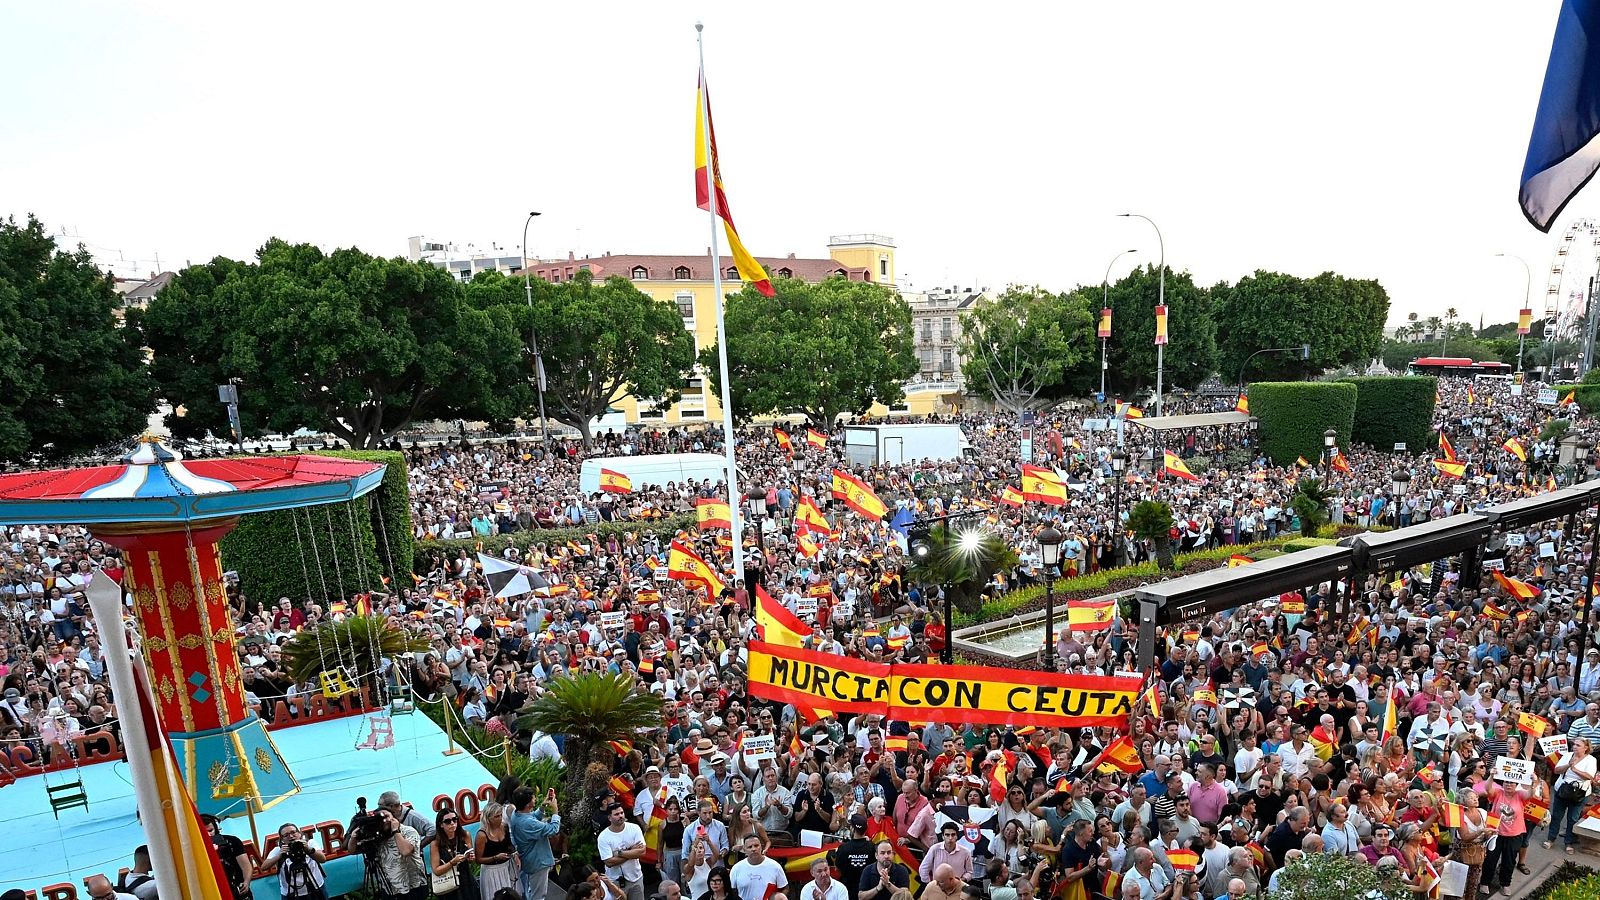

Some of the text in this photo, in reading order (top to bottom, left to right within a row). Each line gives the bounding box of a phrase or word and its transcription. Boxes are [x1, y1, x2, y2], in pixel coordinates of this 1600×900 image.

[769, 656, 1132, 717] MURCIA CON CEUTA
[1505, 760, 1525, 768] MURCIA
[1503, 771, 1523, 780] CEUTA
